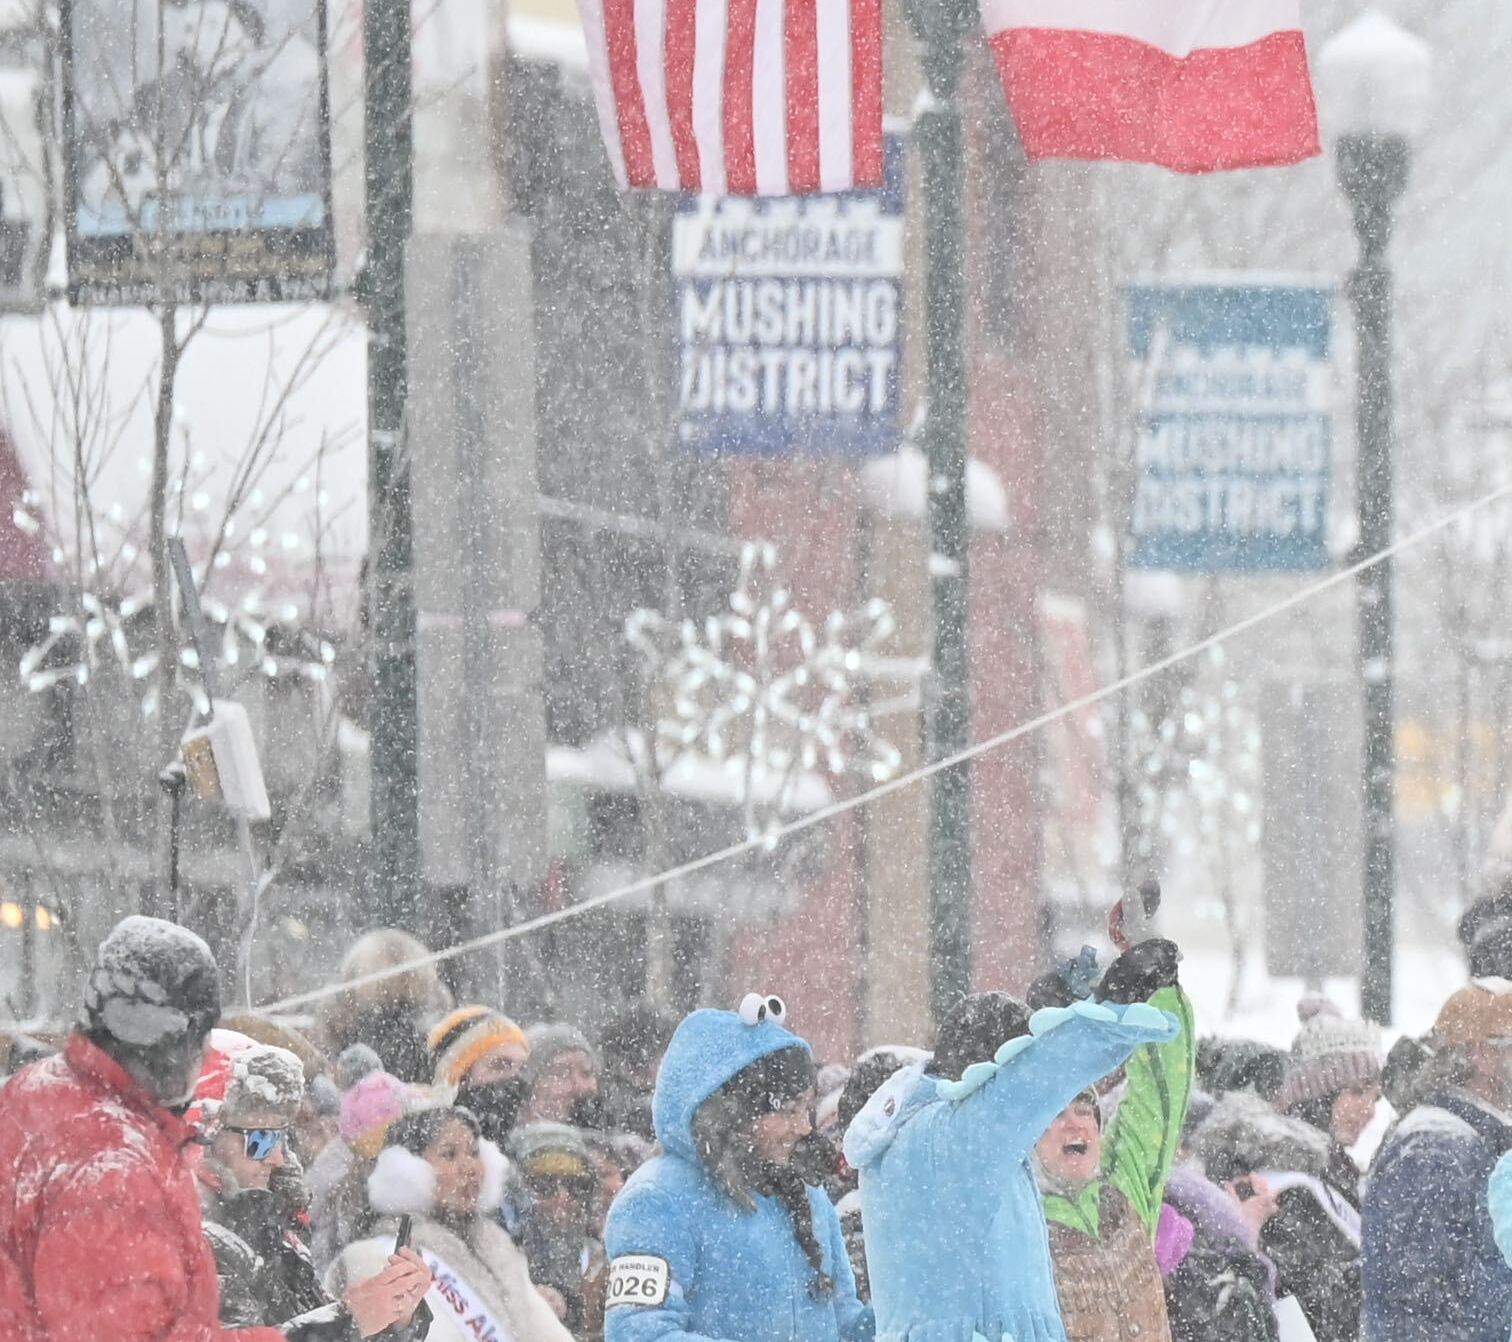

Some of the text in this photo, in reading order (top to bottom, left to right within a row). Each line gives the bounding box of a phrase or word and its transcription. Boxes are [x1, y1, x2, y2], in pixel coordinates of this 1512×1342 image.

[699, 226, 876, 259] ANCHORAGE
[681, 280, 899, 346] MUSHING
[680, 347, 896, 413] DISTRICT
[1137, 416, 1329, 470] MUSHING
[1132, 474, 1325, 535] DISTRICT
[608, 1276, 658, 1297] 026
